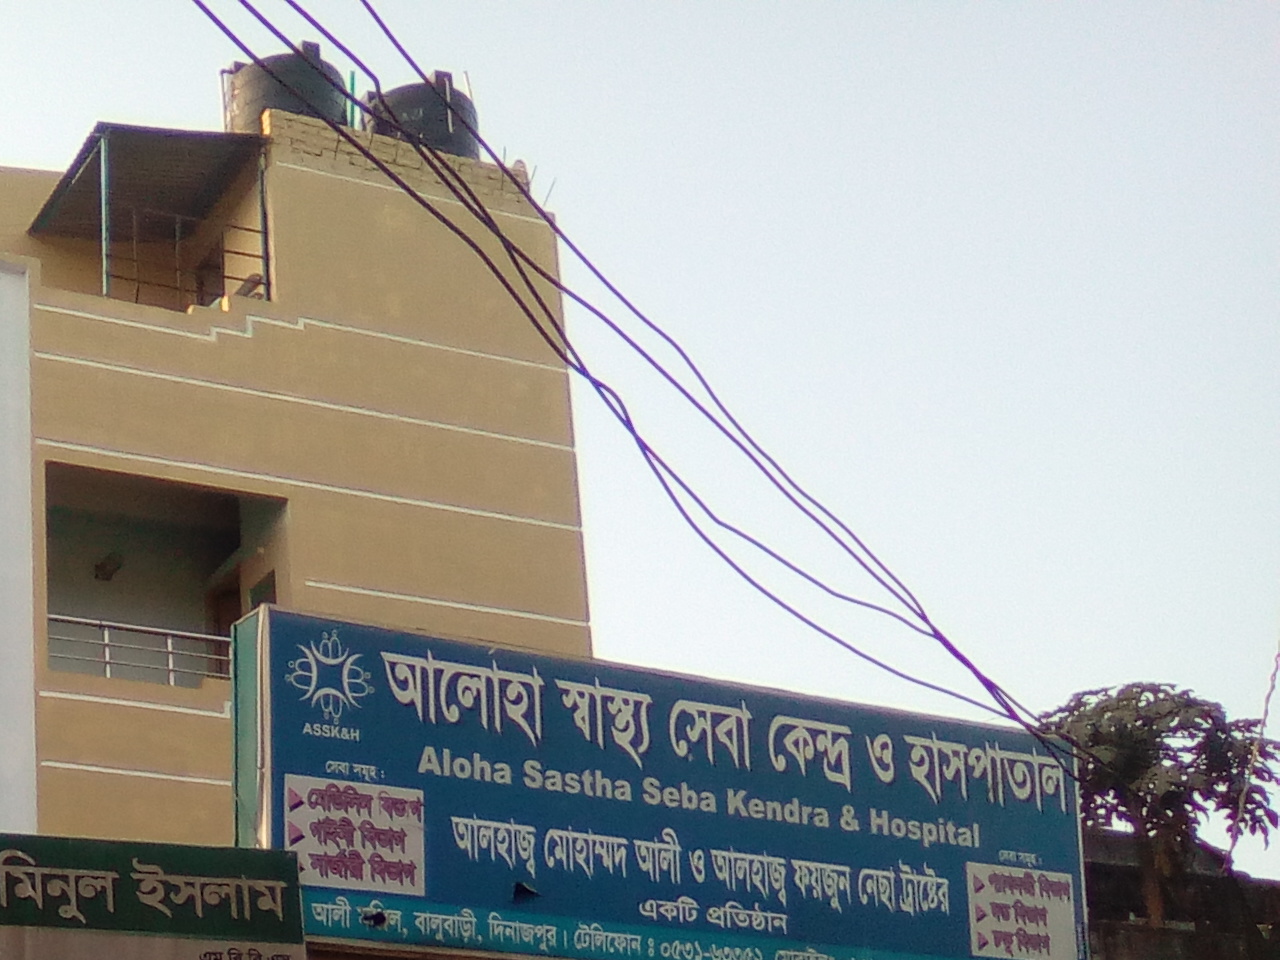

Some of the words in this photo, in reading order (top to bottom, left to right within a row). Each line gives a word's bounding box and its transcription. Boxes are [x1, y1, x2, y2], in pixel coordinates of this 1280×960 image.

[303, 722, 360, 743] ASSK&H
[380, 649, 545, 747] আলোহা
[555, 676, 652, 770] স্বাস্থ্য
[670, 699, 752, 772] সেবা
[769, 715, 852, 793] কেন্দ্র
[866, 733, 894, 784] ও
[904, 732, 1068, 814] হাসপাতাল
[378, 790, 424, 821] বিভাগ
[418, 746, 512, 785] Aloha
[524, 759, 632, 801] Sastha
[642, 777, 716, 813] Seba
[727, 789, 830, 828] Kendra
[840, 805, 859, 831] &
[870, 808, 979, 848] Hospital
[358, 820, 407, 853] বিভাগ
[368, 853, 417, 886] বিভাগ
[450, 813, 536, 879] আলহাজ্ব
[544, 826, 629, 880] মোহাম্মদ
[633, 828, 682, 884] আলী
[689, 849, 705, 883] ও
[710, 846, 787, 908] আলহাজ্ব
[858, 866, 896, 911] নেছা
[130, 857, 287, 921] ইসলাম
[311, 896, 351, 928] আলী
[574, 922, 641, 956] টেলিফোন
[639, 896, 700, 923] একটি
[707, 901, 788, 934] প্রতিষ্ঠান
